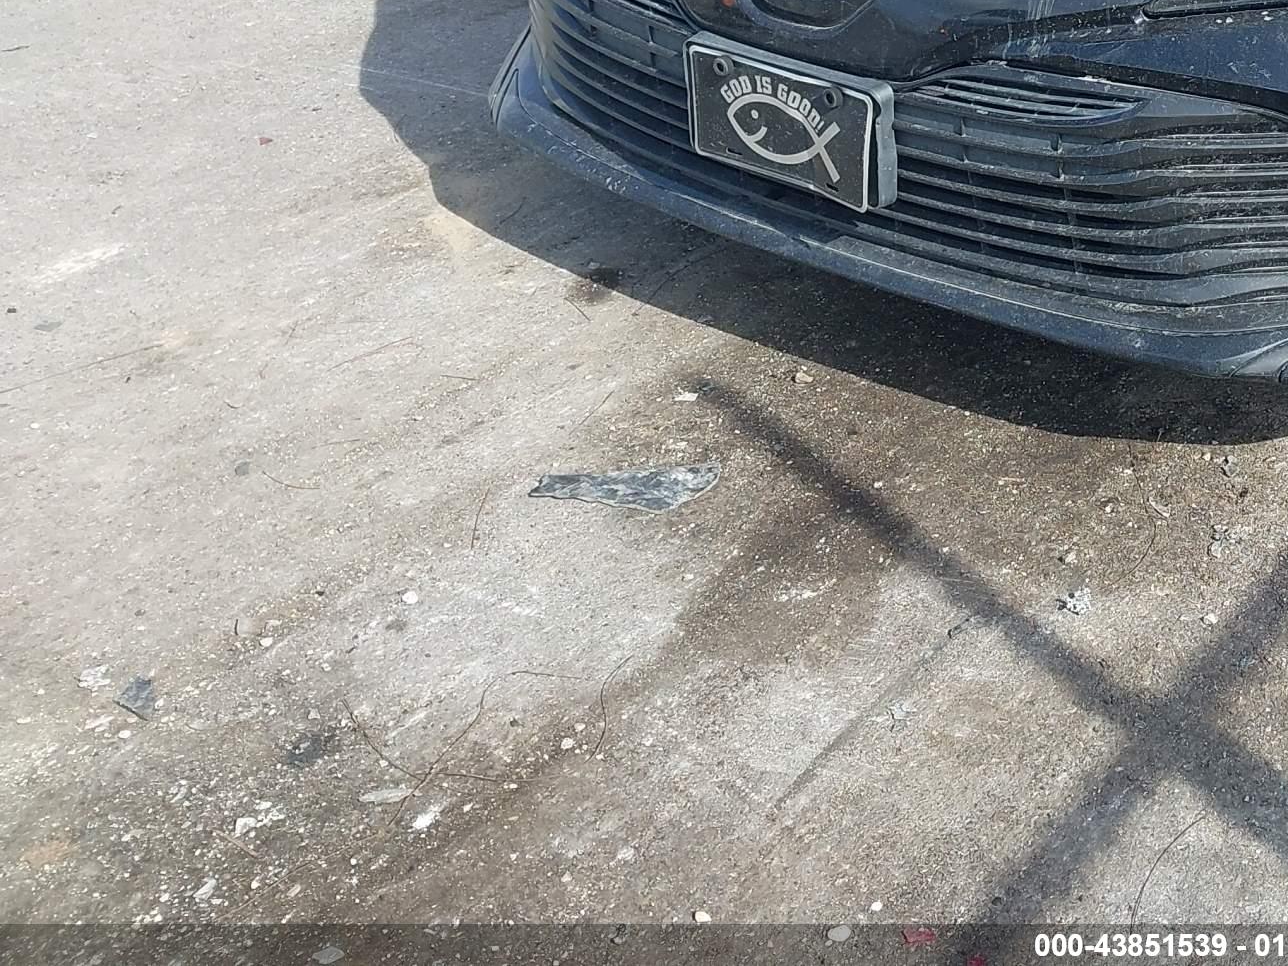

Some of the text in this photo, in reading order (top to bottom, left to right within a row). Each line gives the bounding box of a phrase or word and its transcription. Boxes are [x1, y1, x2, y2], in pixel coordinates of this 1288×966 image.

[720, 75, 825, 133] GOD IS GOOD!
